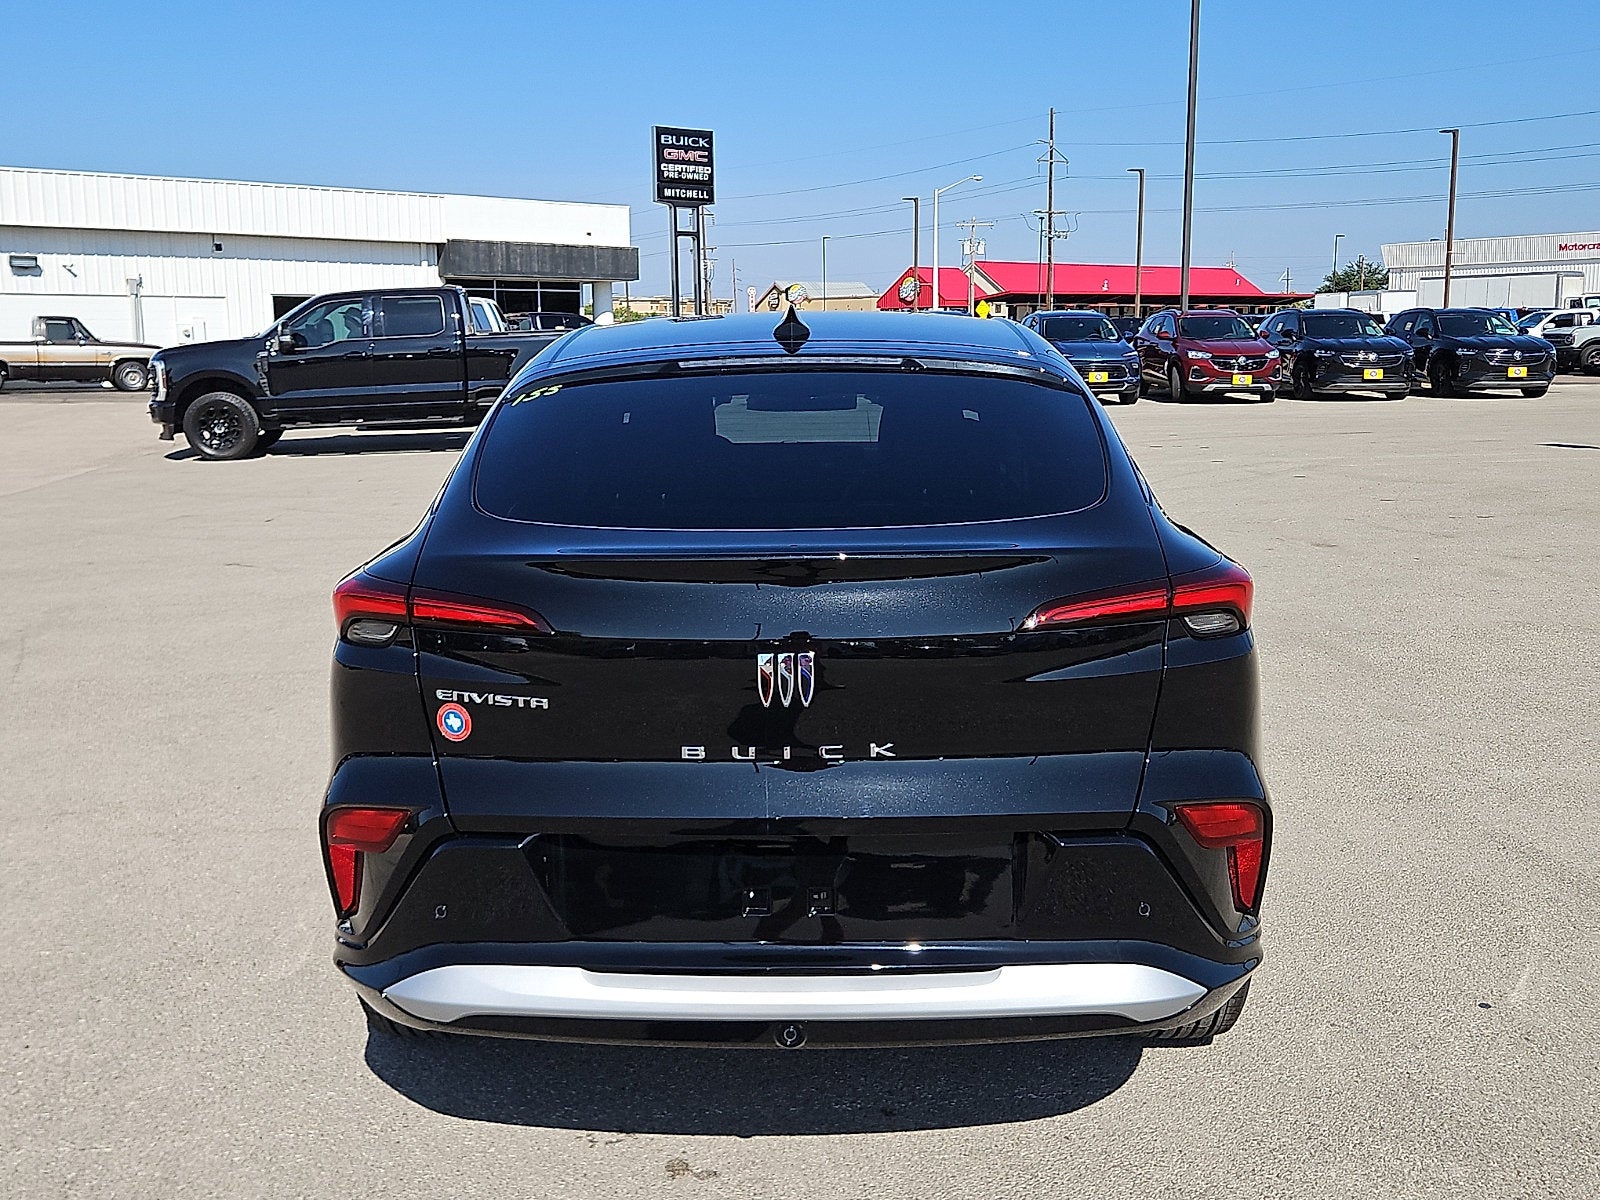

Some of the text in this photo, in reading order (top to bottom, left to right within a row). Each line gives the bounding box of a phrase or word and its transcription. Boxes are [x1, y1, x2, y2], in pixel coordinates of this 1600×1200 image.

[660, 134, 710, 148] BUICK
[663, 148, 709, 163] GMC
[660, 163, 711, 174] CERTIFIED
[663, 171, 709, 181] PRE-OWNED
[664, 188, 709, 199] MITCHELL
[435, 689, 549, 710] ENVISTA
[681, 742, 897, 760] BUICK
